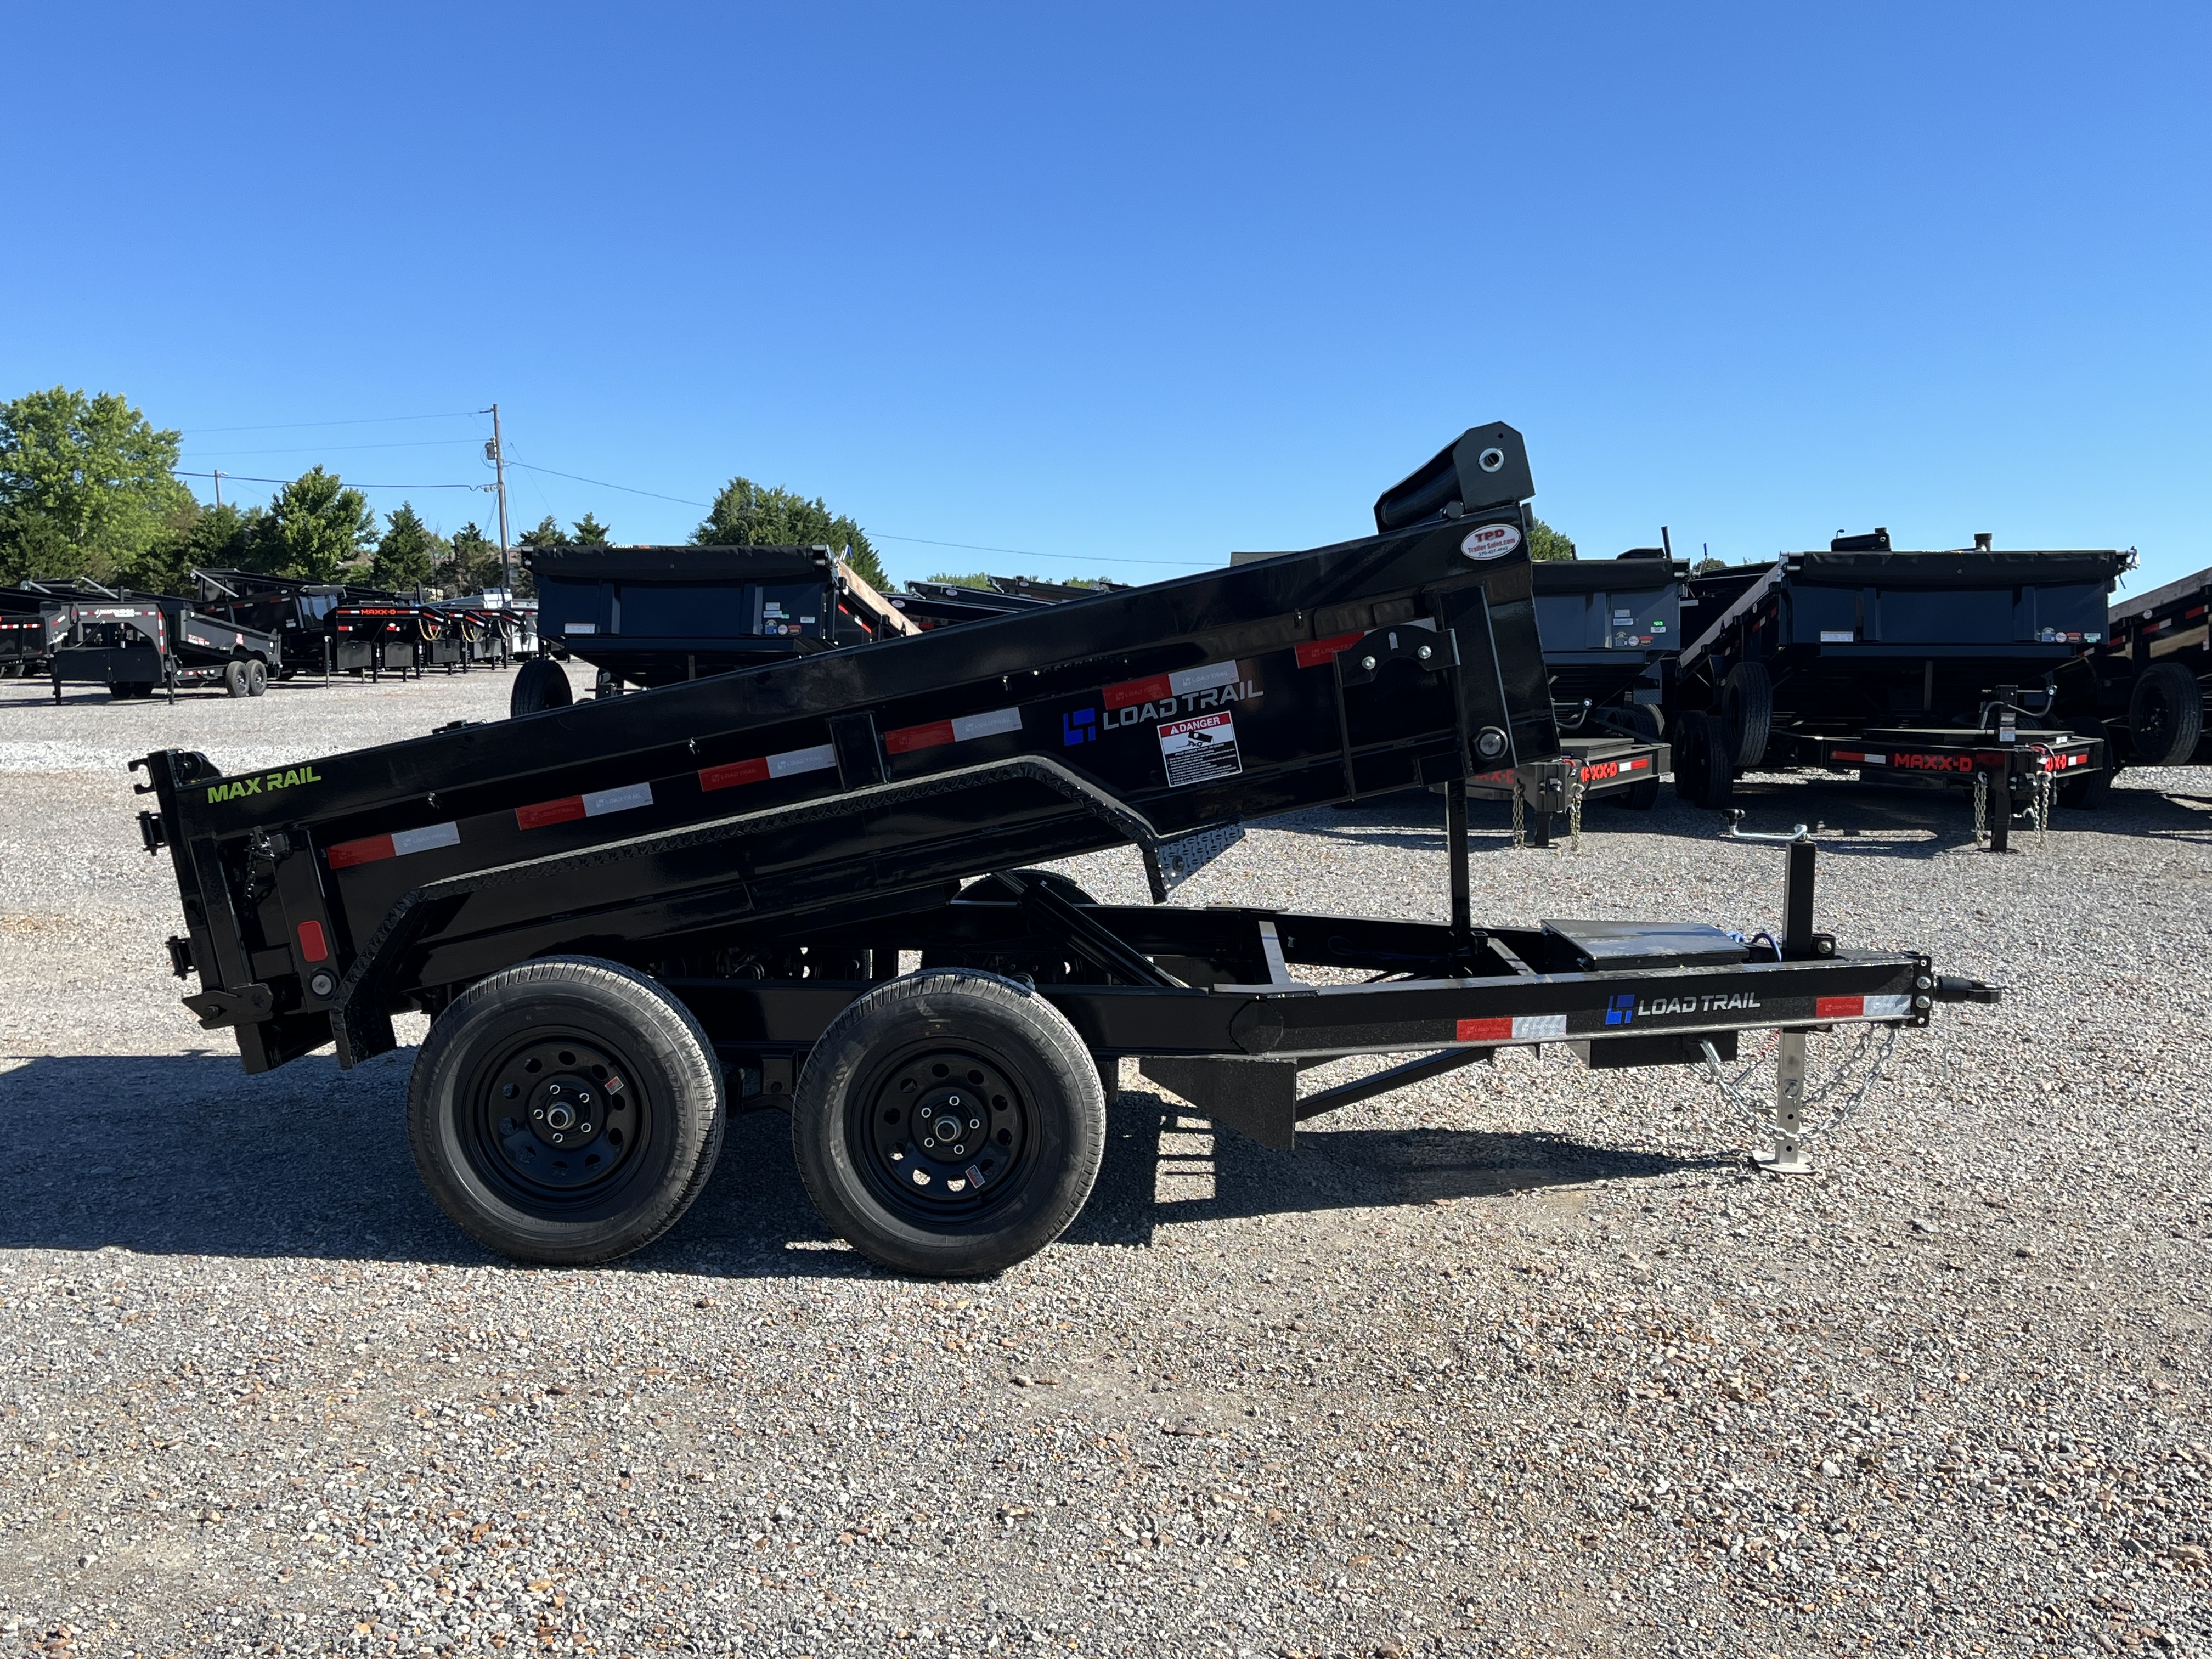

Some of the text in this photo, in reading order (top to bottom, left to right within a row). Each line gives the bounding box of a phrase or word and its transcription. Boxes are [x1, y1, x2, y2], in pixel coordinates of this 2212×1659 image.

[1475, 529, 1505, 543] TPD
[1468, 545, 1486, 553] Trailer
[1103, 698, 1177, 730] LOAD
[1182, 680, 1263, 712] TRAIL
[1180, 716, 1221, 732] DANGER
[1894, 753, 1972, 773] MAXX-D
[207, 766, 321, 803] MAX RAIL
[1638, 996, 1697, 1016] LOAD
[1701, 992, 1761, 1012] TRAIL
